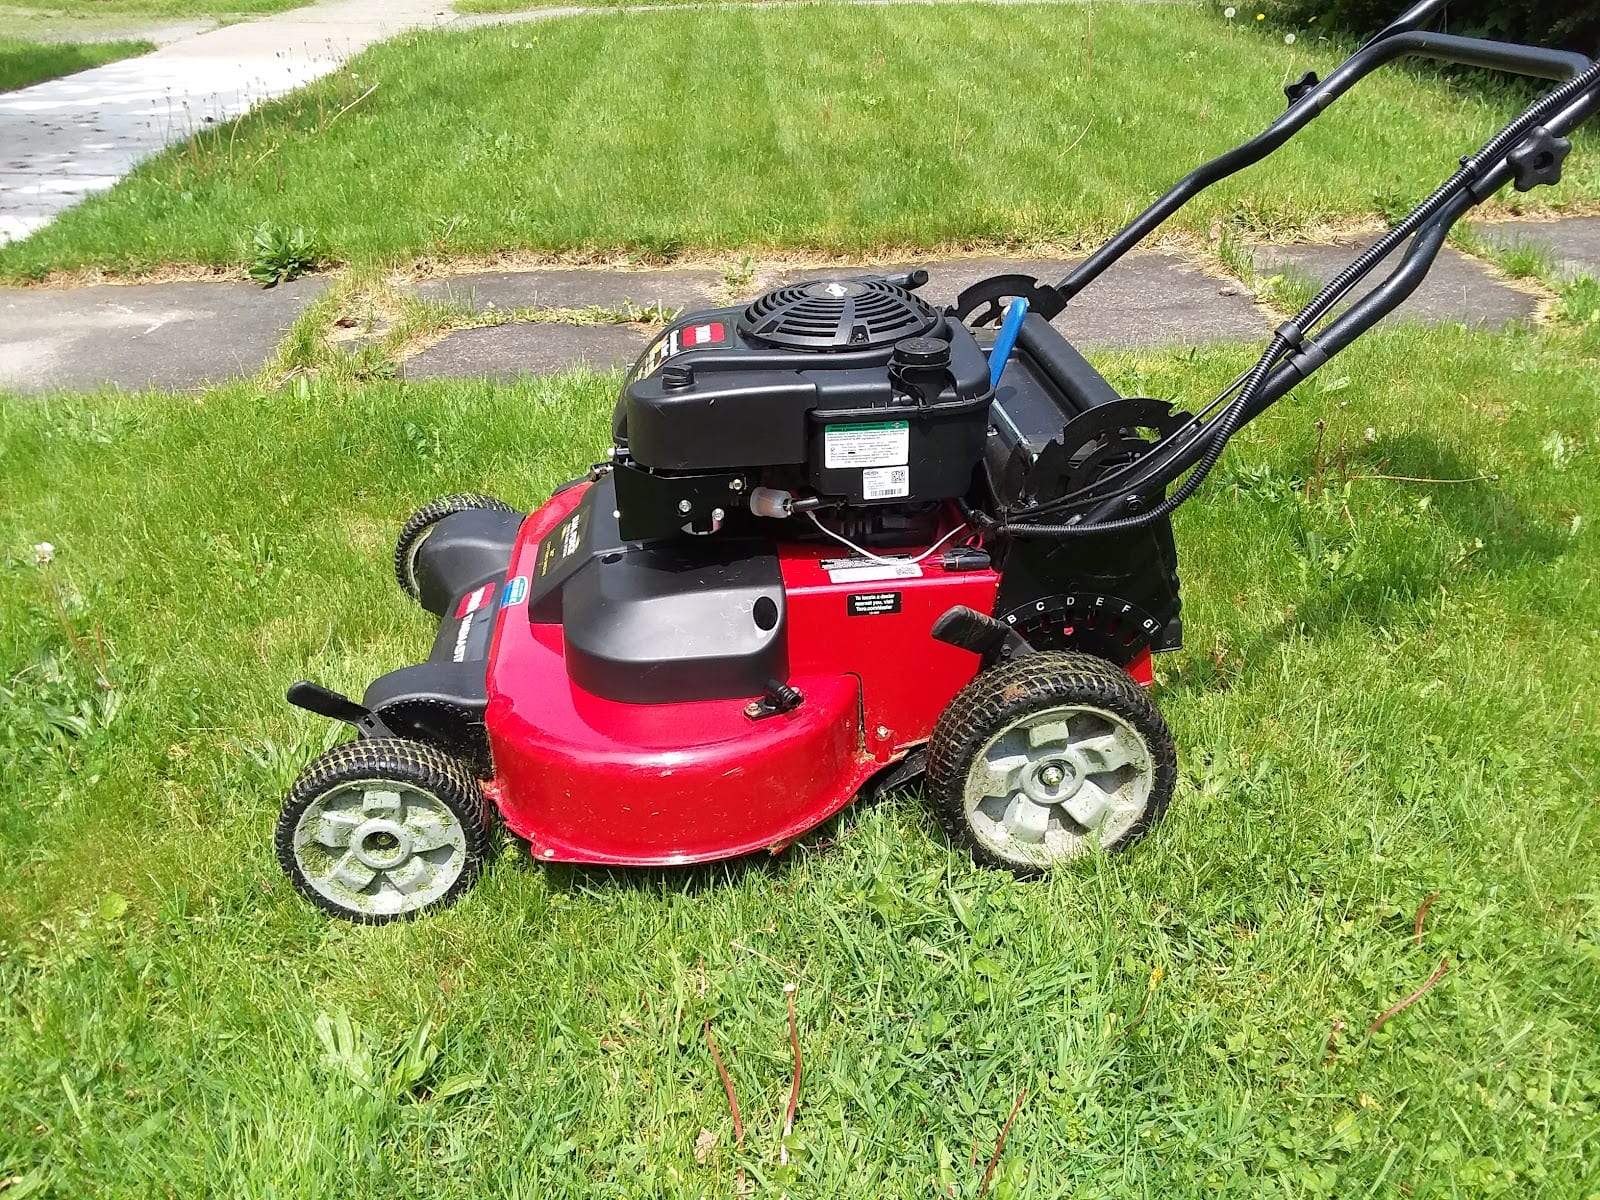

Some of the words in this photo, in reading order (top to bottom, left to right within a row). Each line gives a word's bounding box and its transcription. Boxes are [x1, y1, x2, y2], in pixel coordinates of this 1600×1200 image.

[1035, 601, 1045, 611] C
[1066, 596, 1075, 606] D
[1095, 597, 1105, 606] E
[1121, 604, 1132, 613] F
[1006, 613, 1017, 624] B
[1143, 618, 1153, 628] G
